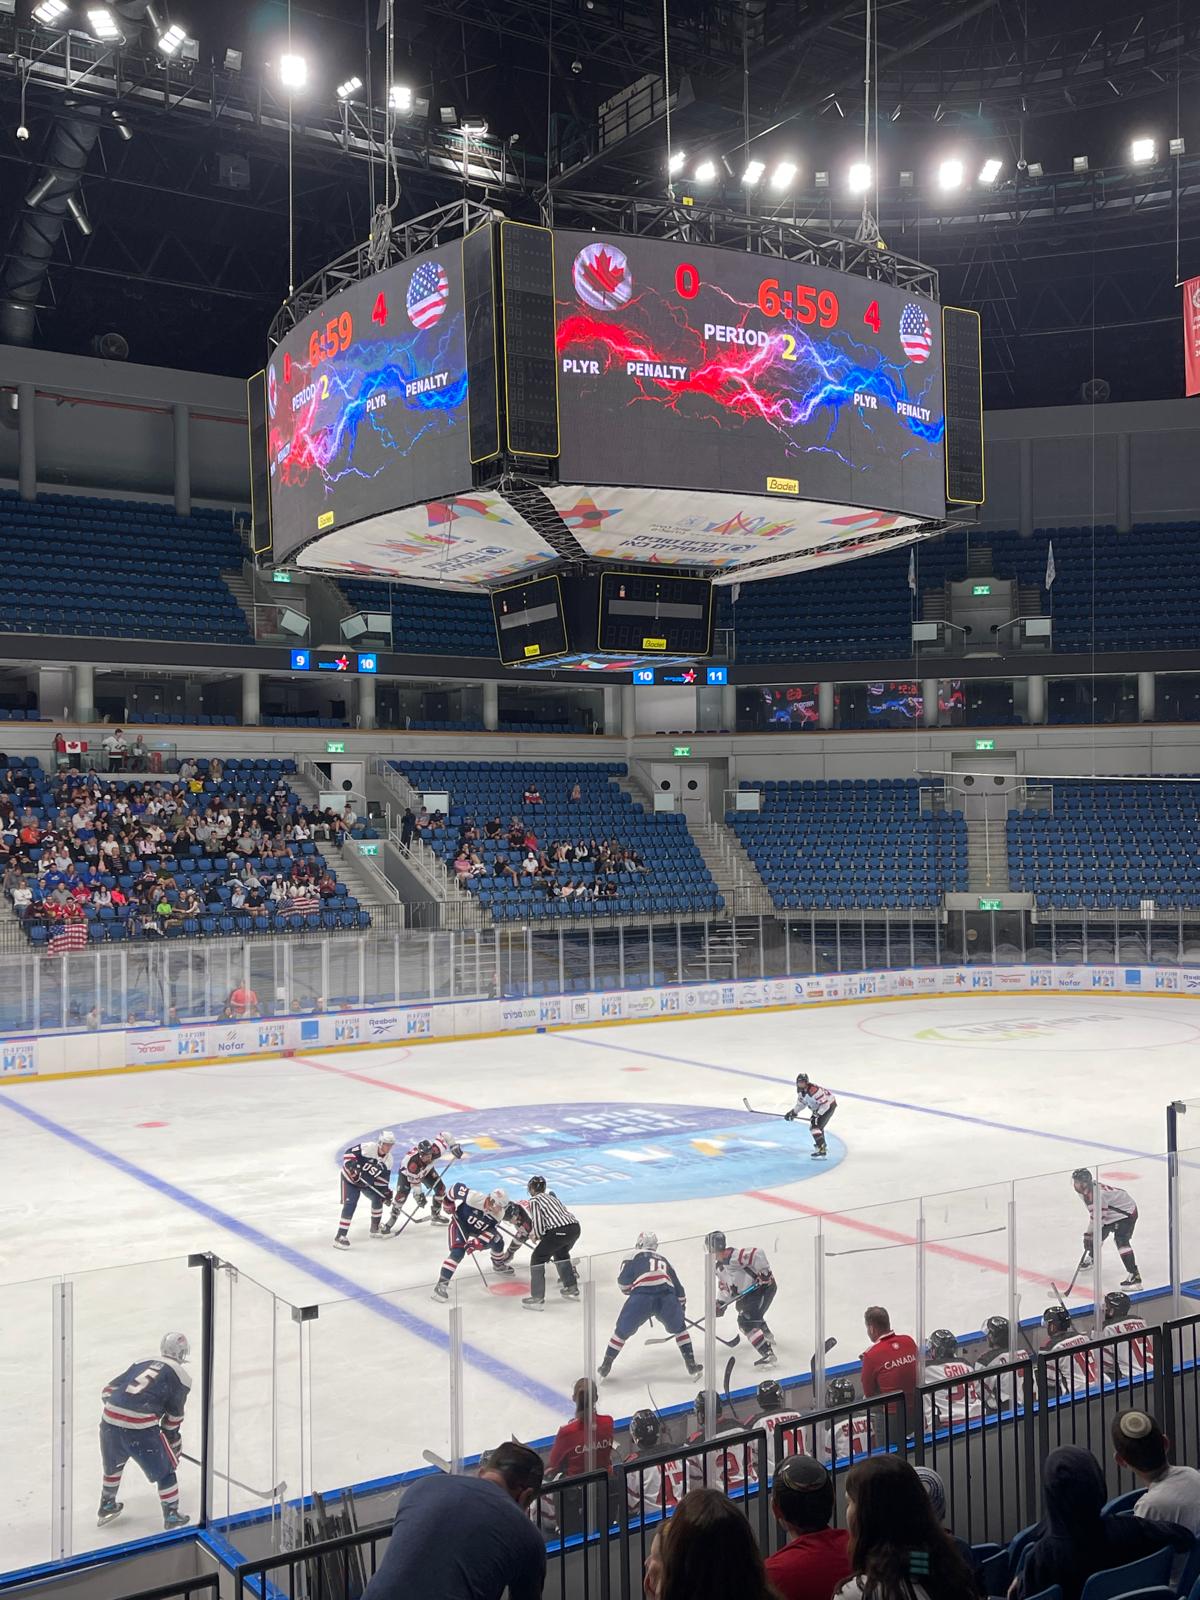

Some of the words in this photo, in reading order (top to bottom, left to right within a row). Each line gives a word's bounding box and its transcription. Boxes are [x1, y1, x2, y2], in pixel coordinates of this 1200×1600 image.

[675, 263, 699, 299] 0
[371, 291, 388, 326] 4
[757, 278, 839, 328] 6:59
[863, 300, 881, 334] 4
[308, 311, 353, 368] 6:59
[704, 323, 769, 347] PERIOD
[781, 334, 797, 361] 2
[562, 359, 600, 375] PLYR
[626, 361, 687, 381] PENALTY
[405, 372, 449, 397] PENALTY
[292, 383, 316, 412] PERIOD
[320, 374, 330, 400] 2
[366, 394, 387, 413] PLYR
[853, 393, 878, 410] PLYR
[896, 401, 931, 422] PENALTY
[769, 479, 798, 492] Bodet
[645, 639, 665, 648] Bodet
[296, 655, 305, 666] 9
[360, 658, 373, 669] 10
[637, 671, 653, 681] 10
[709, 671, 723, 681] 11
[1030, 975, 1052, 986] M21
[1092, 975, 1114, 986] M21
[335, 1026, 360, 1041] M21
[407, 1019, 431, 1034] M21
[218, 1041, 245, 1051] Nofar
[259, 1032, 285, 1047] M21
[178, 1040, 206, 1055] M21
[3, 1055, 34, 1071] M21
[125, 1368, 160, 1395] 5
